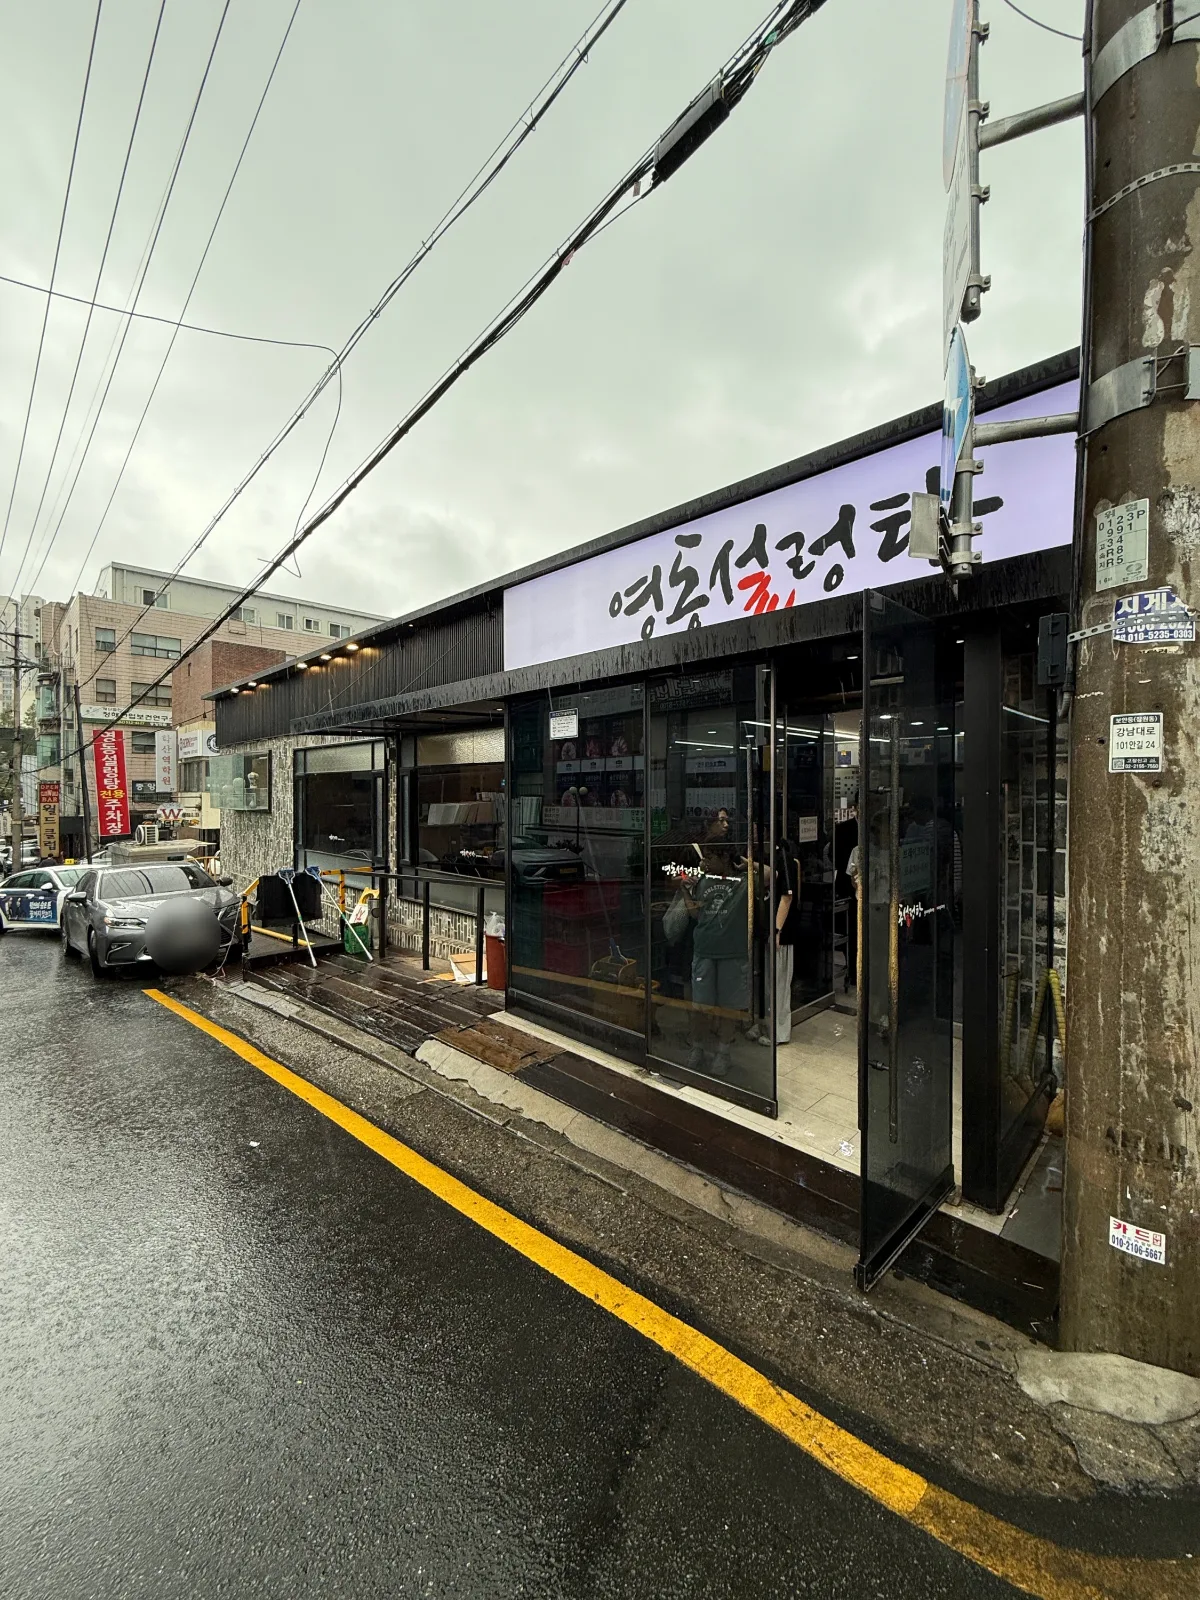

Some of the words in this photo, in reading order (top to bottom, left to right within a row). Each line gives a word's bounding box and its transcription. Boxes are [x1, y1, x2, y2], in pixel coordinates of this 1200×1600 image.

[1127, 629, 1193, 642] 010-5235-0303
[103, 711, 171, 722] 정해업보건연구
[1116, 726, 1156, 737] 강남대로
[1116, 740, 1143, 750] 101안길
[1145, 740, 1156, 749] 24
[101, 731, 120, 790] 영동설렁탕
[100, 789, 125, 799] 전용
[42, 804, 56, 825] 월드
[104, 799, 123, 834] 주차장
[43, 828, 56, 851] 클럽
[898, 901, 924, 928] 동설렁탕
[1112, 1219, 1150, 1243] 카드
[1111, 1234, 1163, 1261] 010-2106-5667
